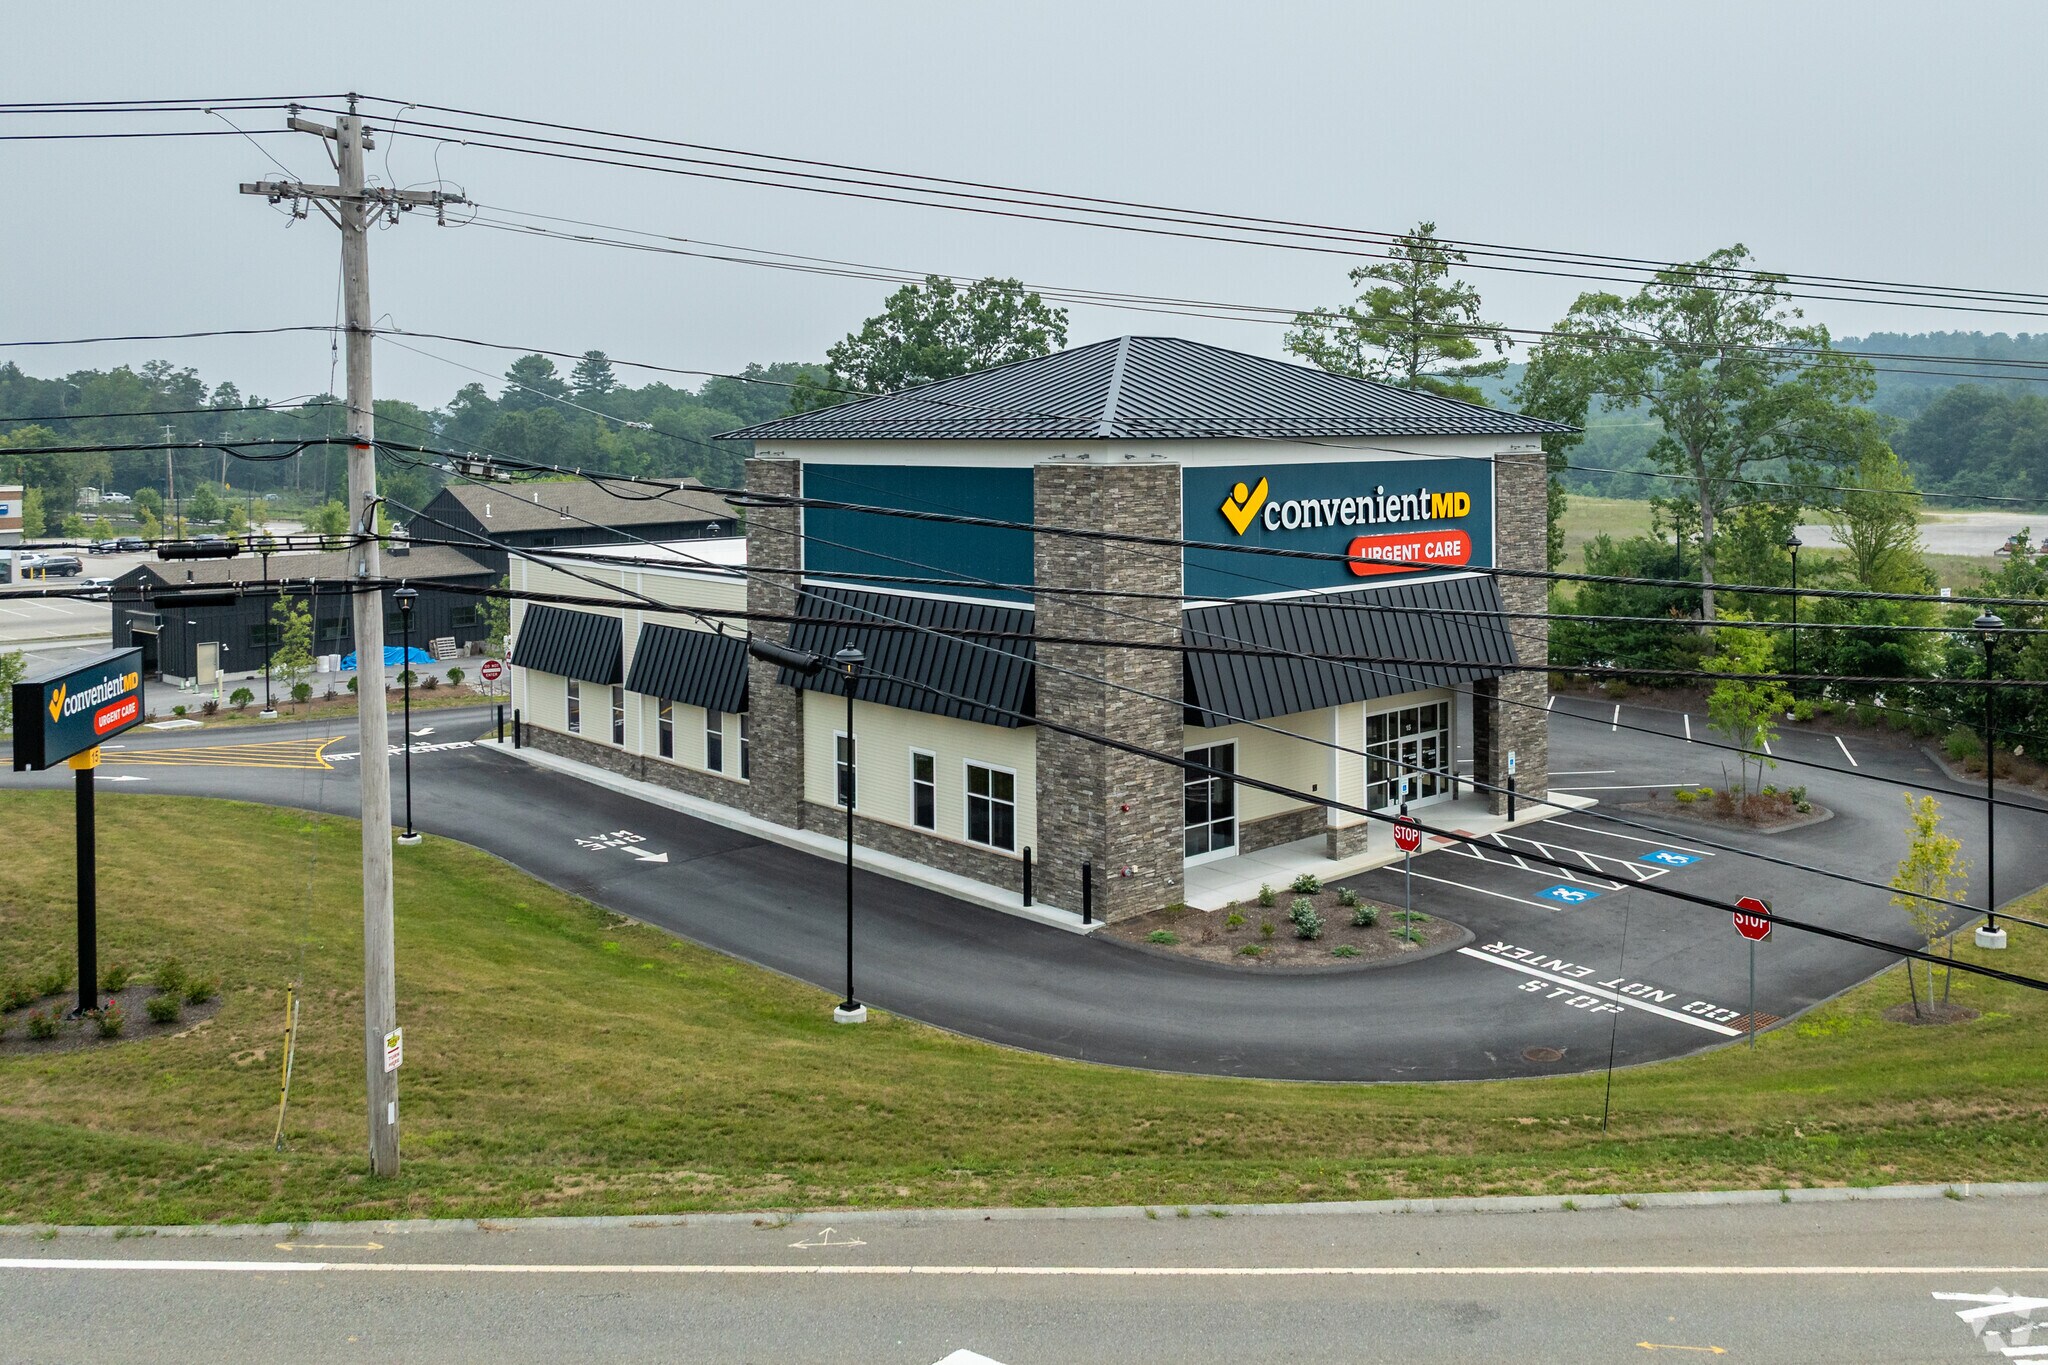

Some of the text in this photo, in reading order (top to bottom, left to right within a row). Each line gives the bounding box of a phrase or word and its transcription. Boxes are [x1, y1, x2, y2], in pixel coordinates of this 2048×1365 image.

[1264, 485, 1471, 531] convenientMD
[1361, 540, 1461, 561] URGENT CARE
[64, 672, 139, 717] convenientMD
[98, 702, 136, 728] URGENT CARE
[91, 750, 98, 763] 15
[1395, 826, 1419, 842] STOP
[1482, 941, 1741, 1022] DO NOT ENTER
[1518, 979, 1625, 1014] STOP
